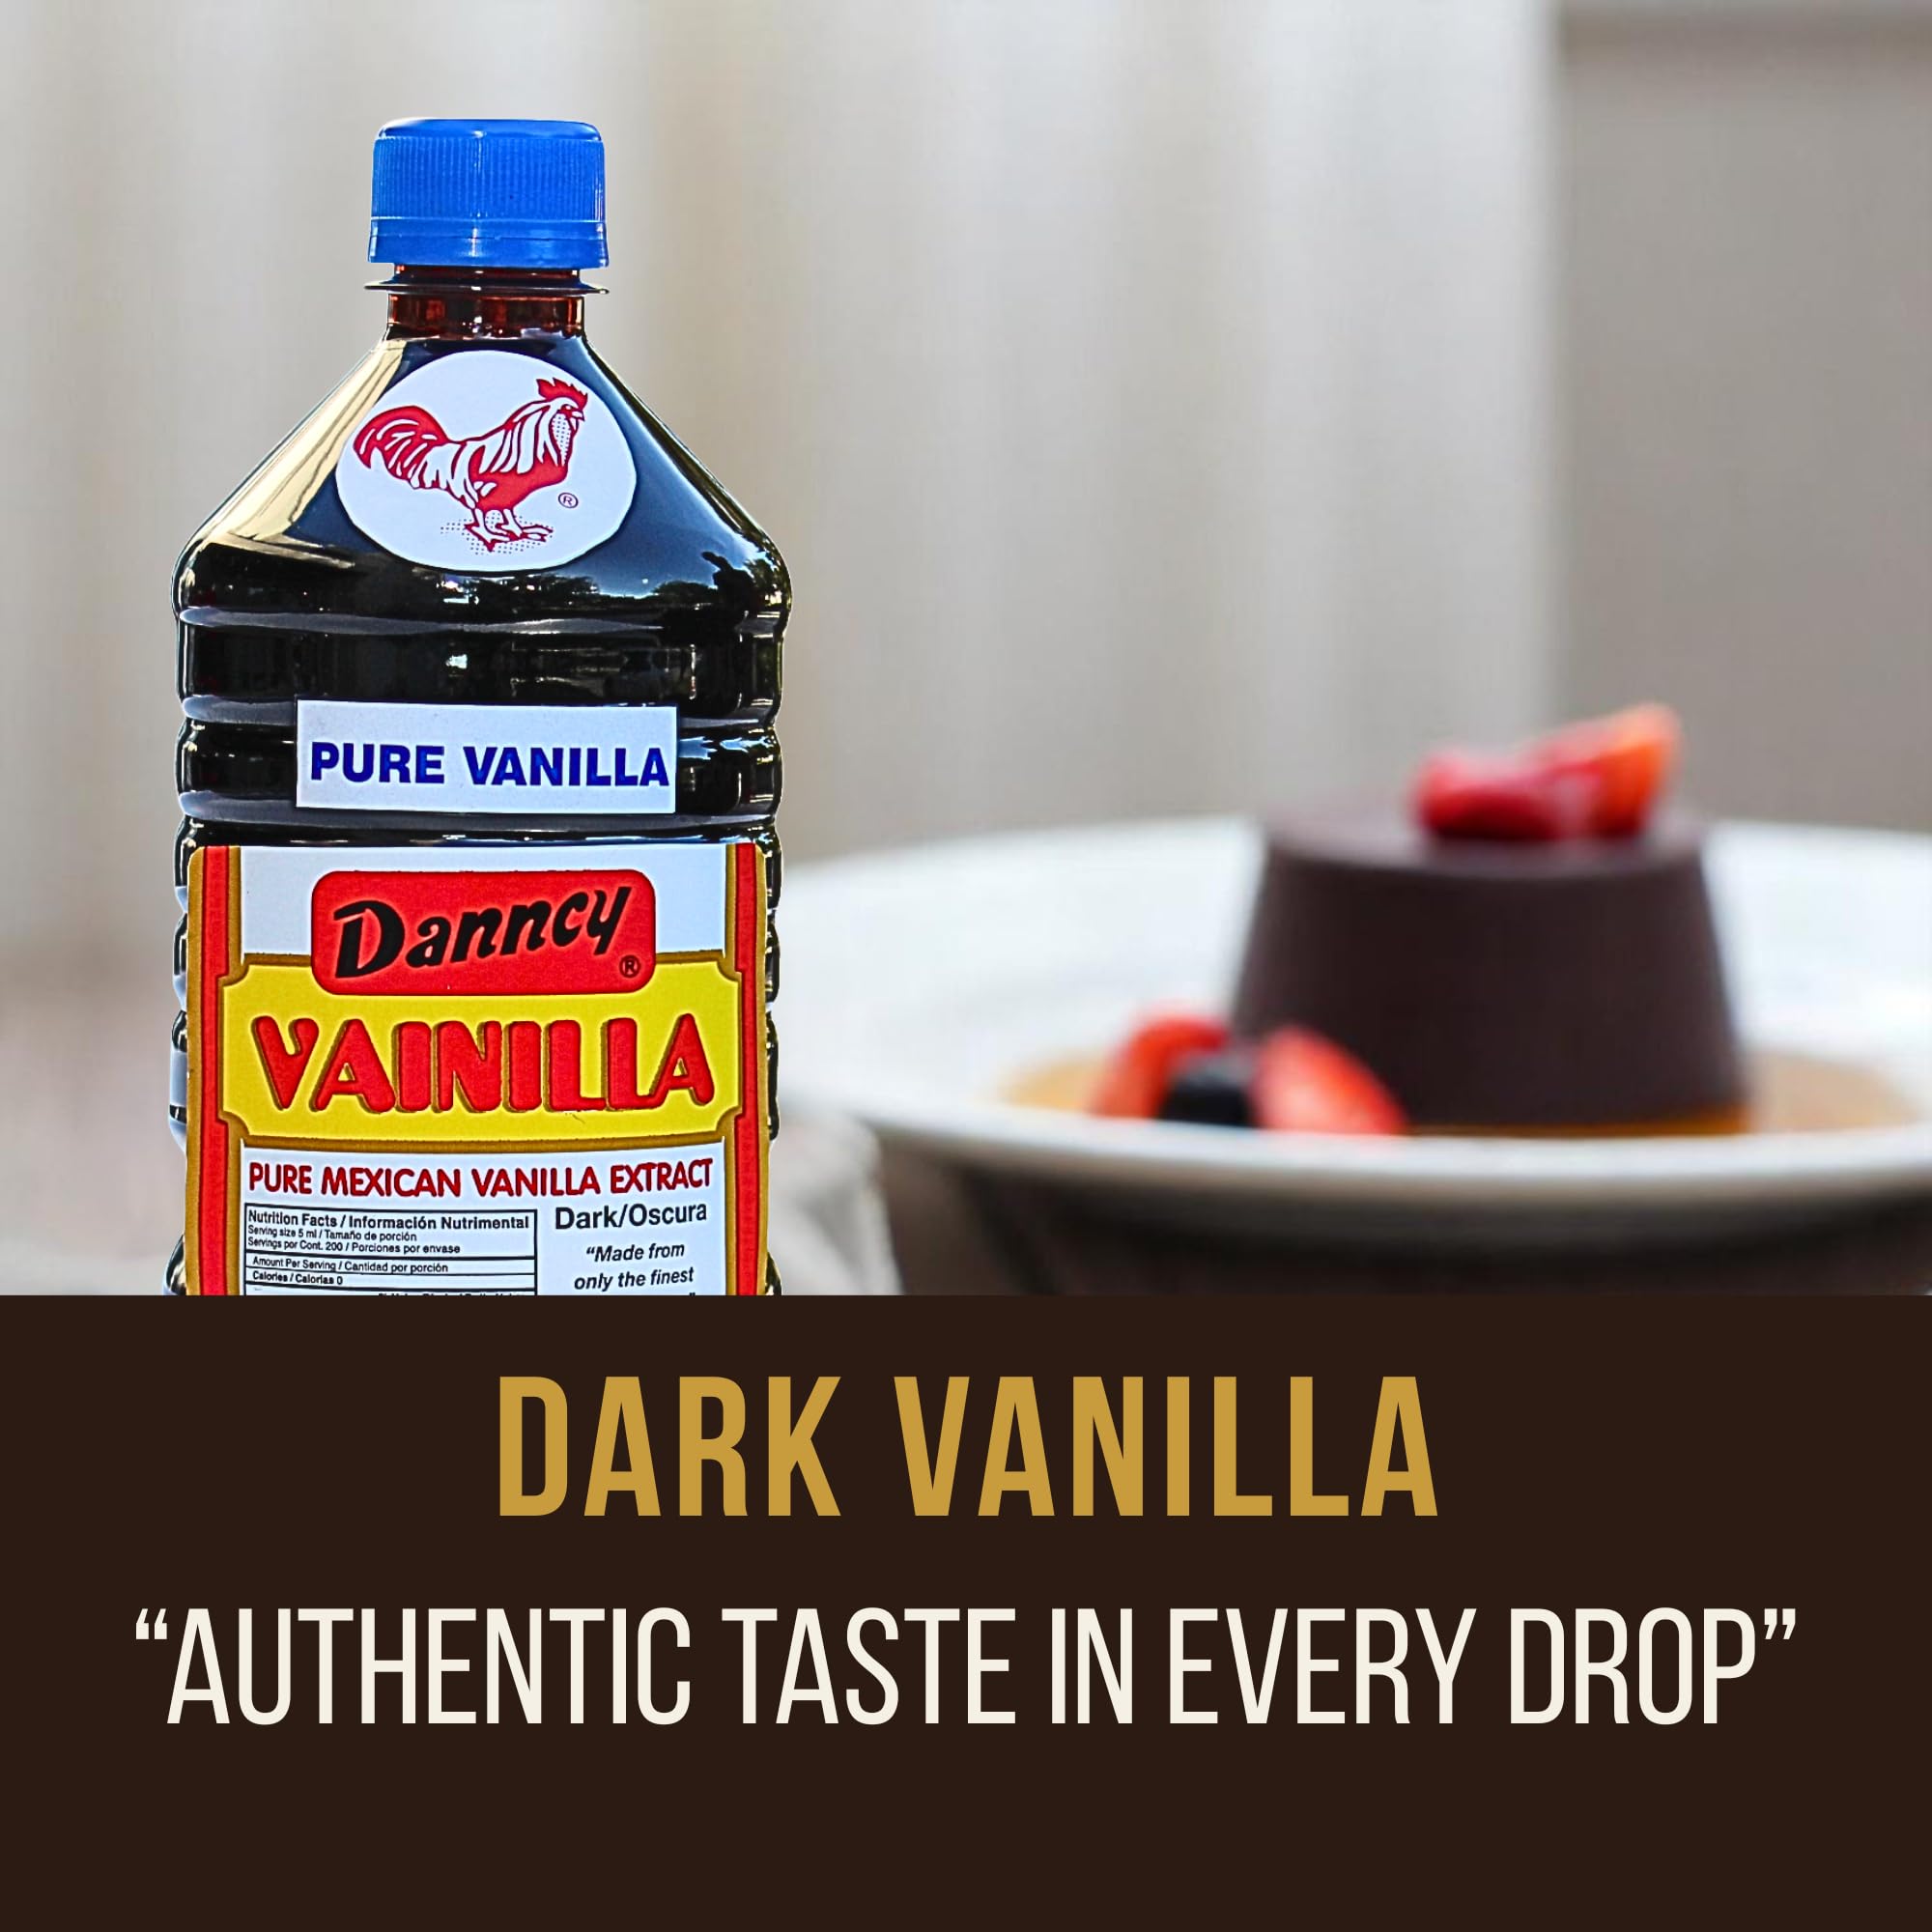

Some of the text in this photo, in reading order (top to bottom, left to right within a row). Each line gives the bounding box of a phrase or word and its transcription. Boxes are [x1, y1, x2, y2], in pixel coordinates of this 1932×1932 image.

[311, 742, 669, 787] PURE VANILLA
[333, 887, 630, 978] Danncy
[251, 1013, 715, 1113] VAINILLA
[249, 1157, 714, 1198] PURE MEXICAN VANILLA EXTRACT
[248, 1209, 298, 1226] Nutrition
[301, 1213, 338, 1228] Facts
[349, 1215, 437, 1230] Información
[441, 1215, 529, 1230] Nutrimental
[554, 1204, 707, 1230] Dark/Oscura
[247, 1224, 278, 1238] Serving
[279, 1228, 297, 1237] size
[298, 1228, 304, 1238] 5
[305, 1229, 317, 1238] ml
[325, 1230, 362, 1240] Tamaño
[364, 1231, 378, 1240] de
[380, 1231, 417, 1243] porción
[247, 1236, 282, 1249] Servings
[299, 1240, 324, 1251] Cont.
[326, 1241, 343, 1251] 200
[352, 1242, 401, 1254] Porciones
[403, 1244, 421, 1255] por
[422, 1244, 461, 1254] envase
[585, 1242, 685, 1263] “Made from
[252, 1256, 284, 1267] Amount
[285, 1258, 300, 1268] Per
[302, 1260, 336, 1272] Serving
[344, 1261, 388, 1272] Cantidad
[390, 1264, 408, 1274] por
[410, 1262, 449, 1275] porción
[252, 1270, 289, 1283] Calories
[574, 1266, 695, 1293] only the finest
